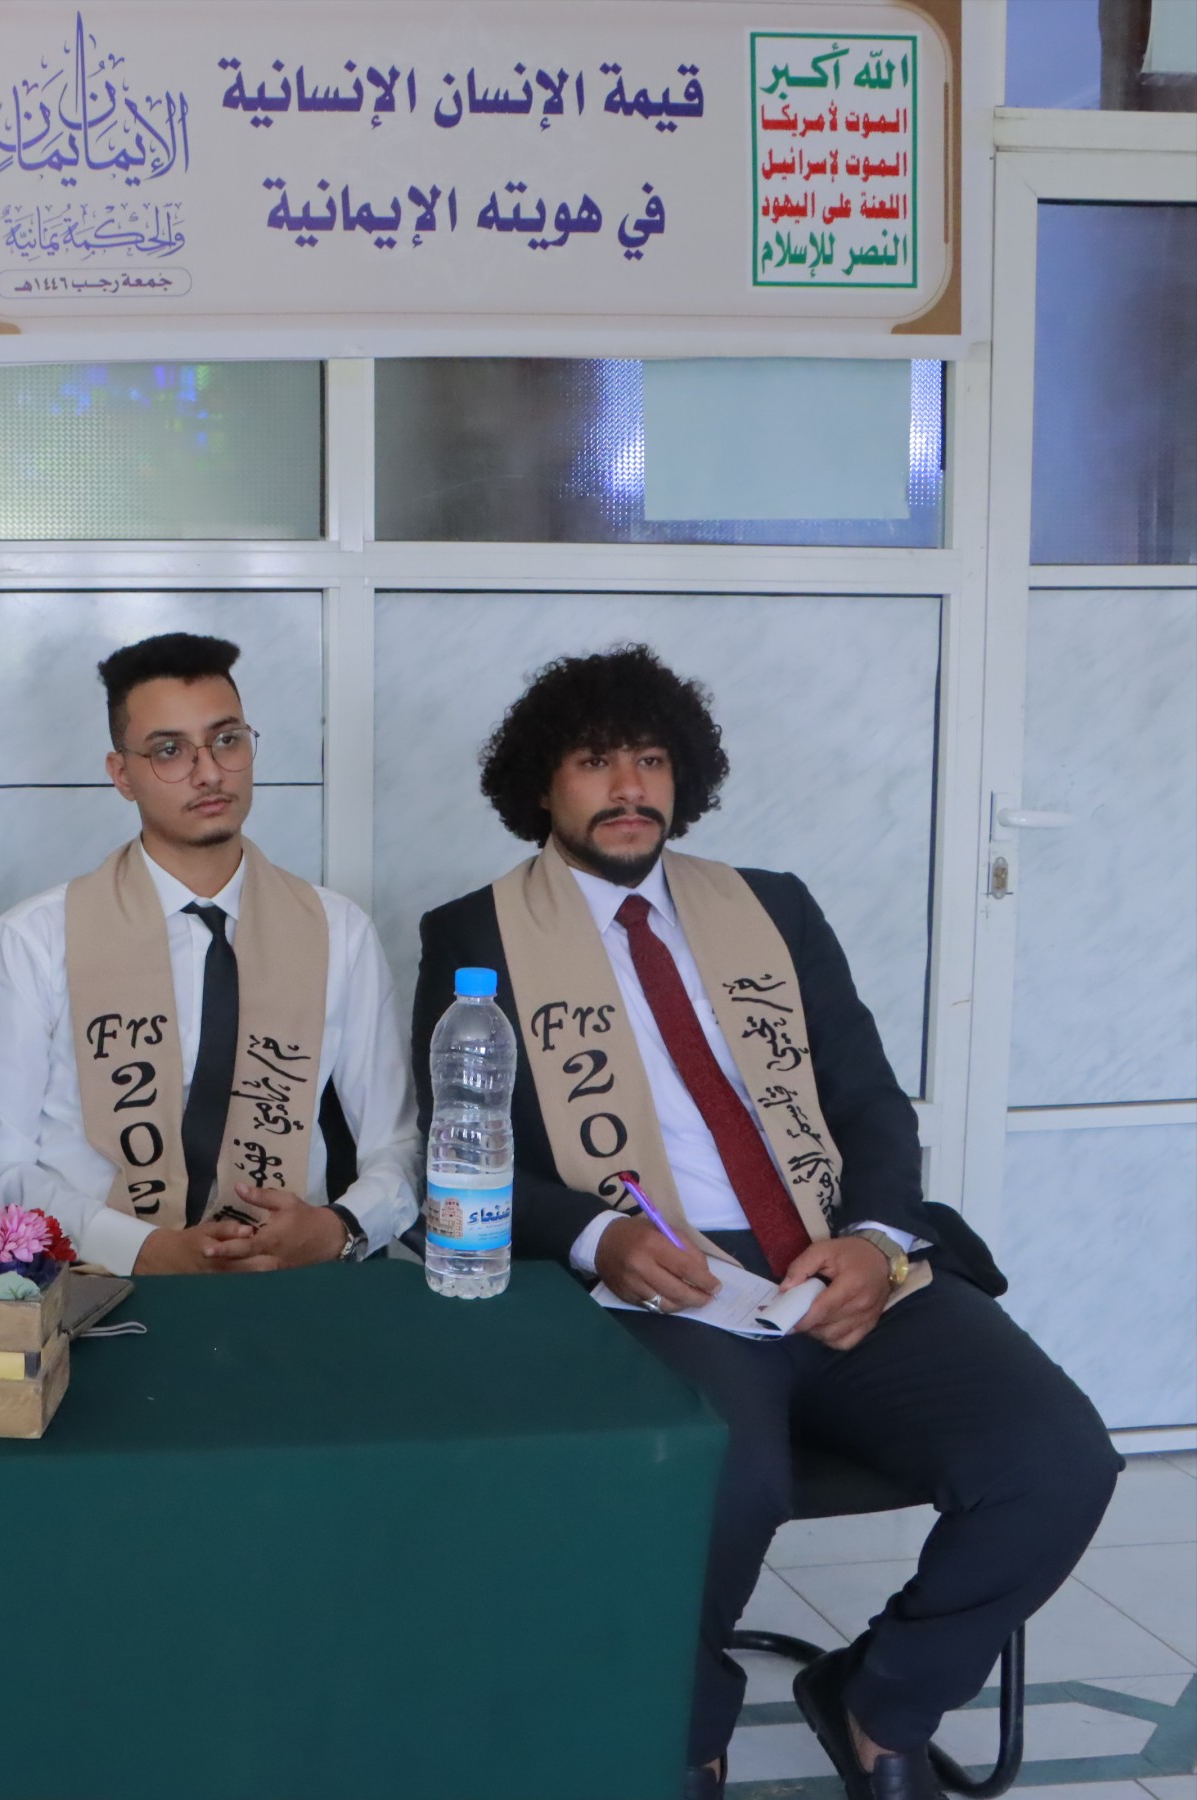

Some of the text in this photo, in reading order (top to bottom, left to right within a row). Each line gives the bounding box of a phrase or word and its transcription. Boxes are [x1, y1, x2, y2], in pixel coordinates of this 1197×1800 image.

[217, 57, 704, 133] قيمة الإنسان الإنسانية
[759, 42, 909, 100] الله أكبر
[761, 99, 908, 139] الموت لأمريكا
[761, 146, 908, 183] الموت لإسرائيل
[262, 177, 667, 261] في هويته الإيمانية
[761, 191, 908, 225] اللعنة على اليهود
[761, 228, 908, 278] النصر للإسلام
[71, 277, 120, 293] رجب
[122, 273, 173, 292] جمعة
[86, 1013, 168, 1060] Frs
[531, 1001, 616, 1052] Frs
[233, 1138, 287, 1189] فهم
